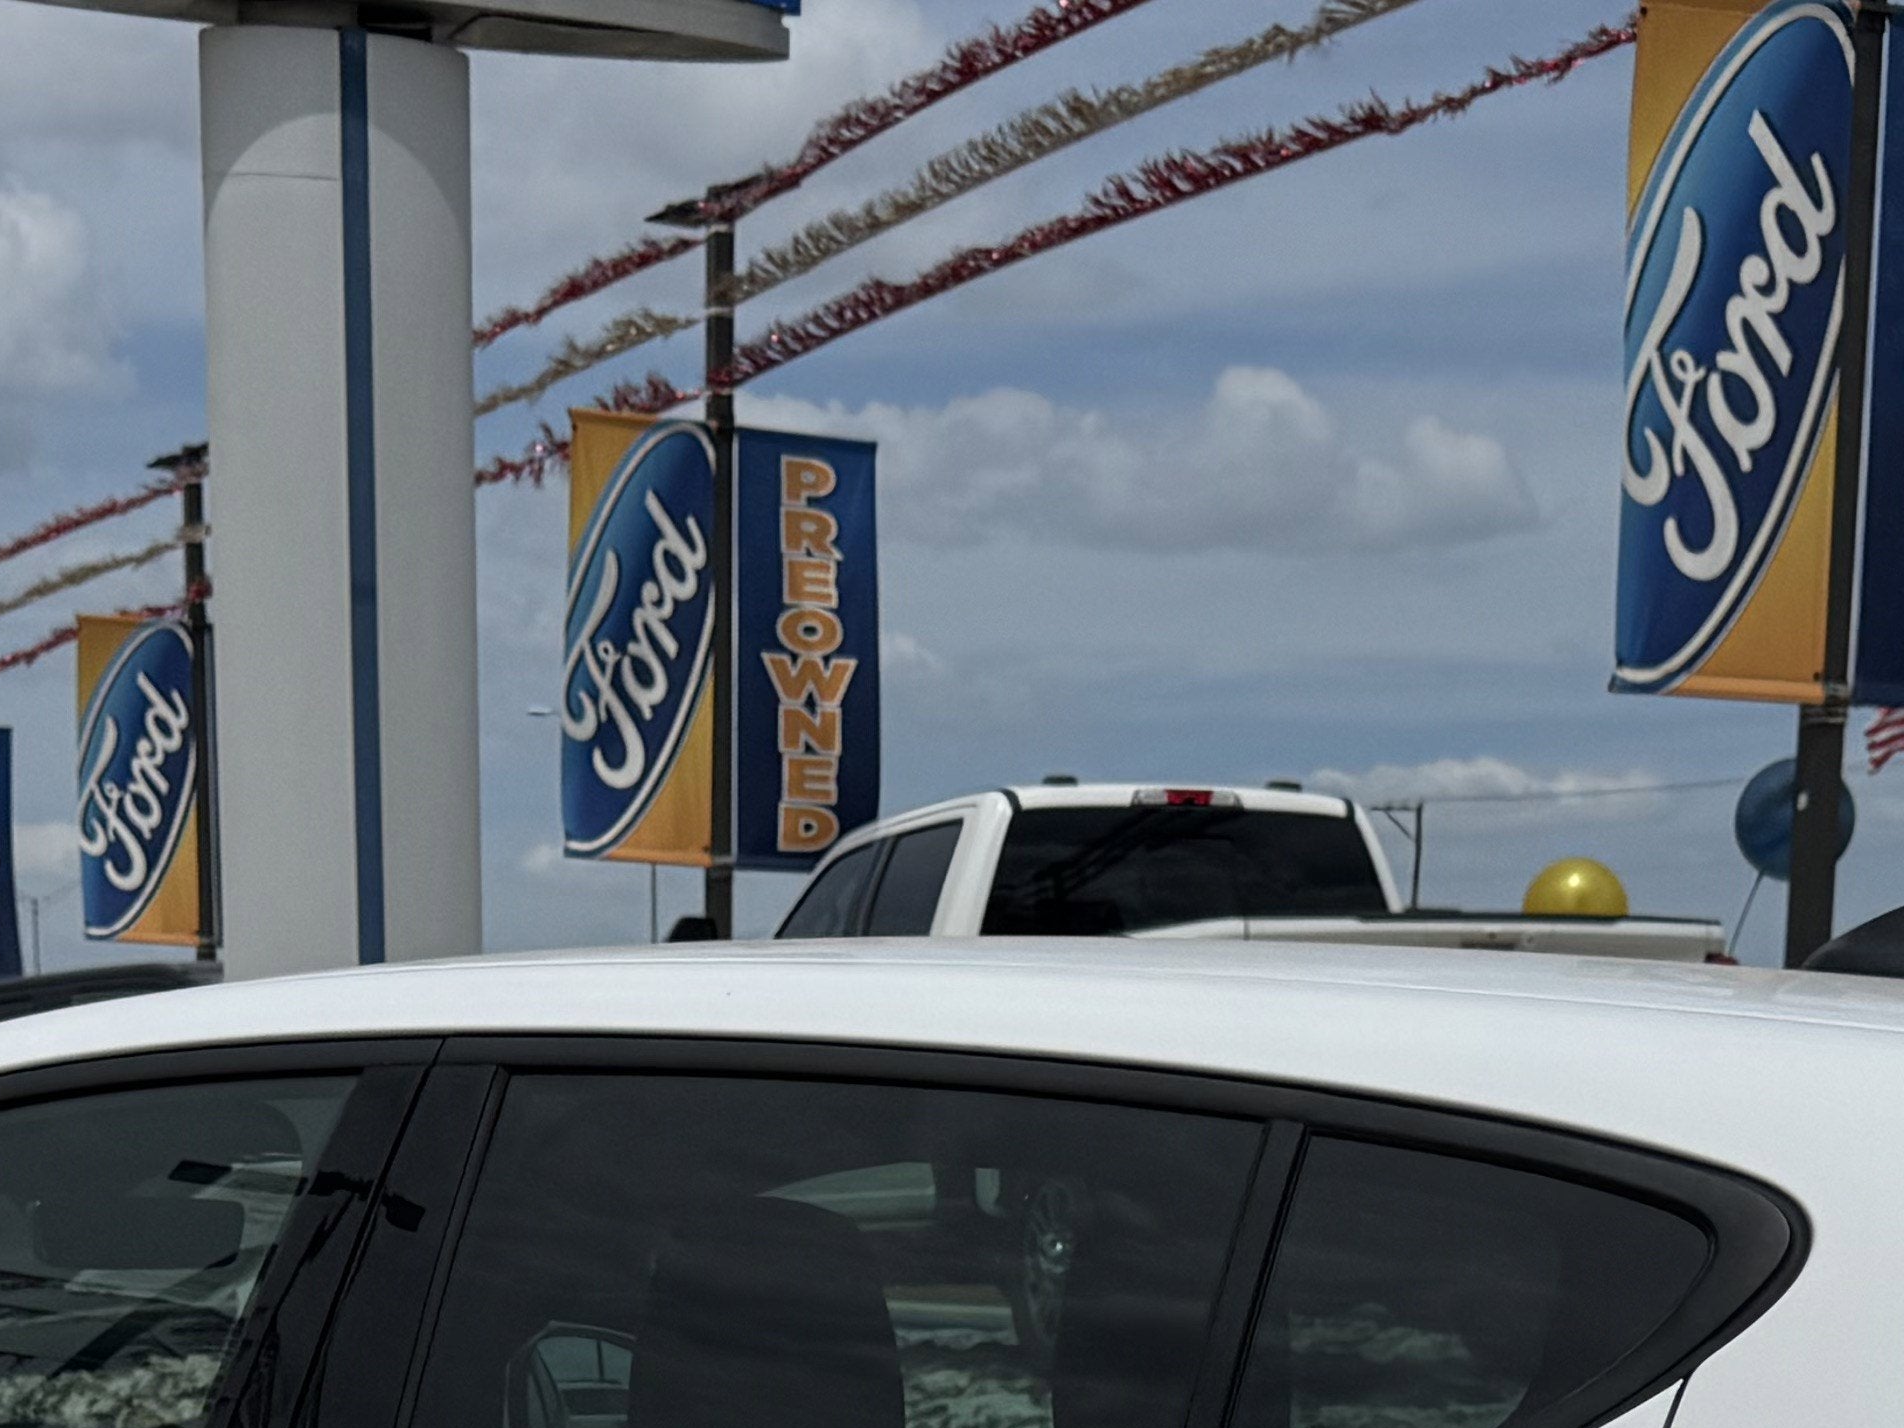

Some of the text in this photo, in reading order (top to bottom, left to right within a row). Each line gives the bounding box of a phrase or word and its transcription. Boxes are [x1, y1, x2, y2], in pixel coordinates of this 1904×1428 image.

[1622, 109, 1837, 581] Ford
[78, 671, 189, 891] Ford
[562, 488, 707, 790] Ford
[760, 454, 859, 852] PREOWNED
